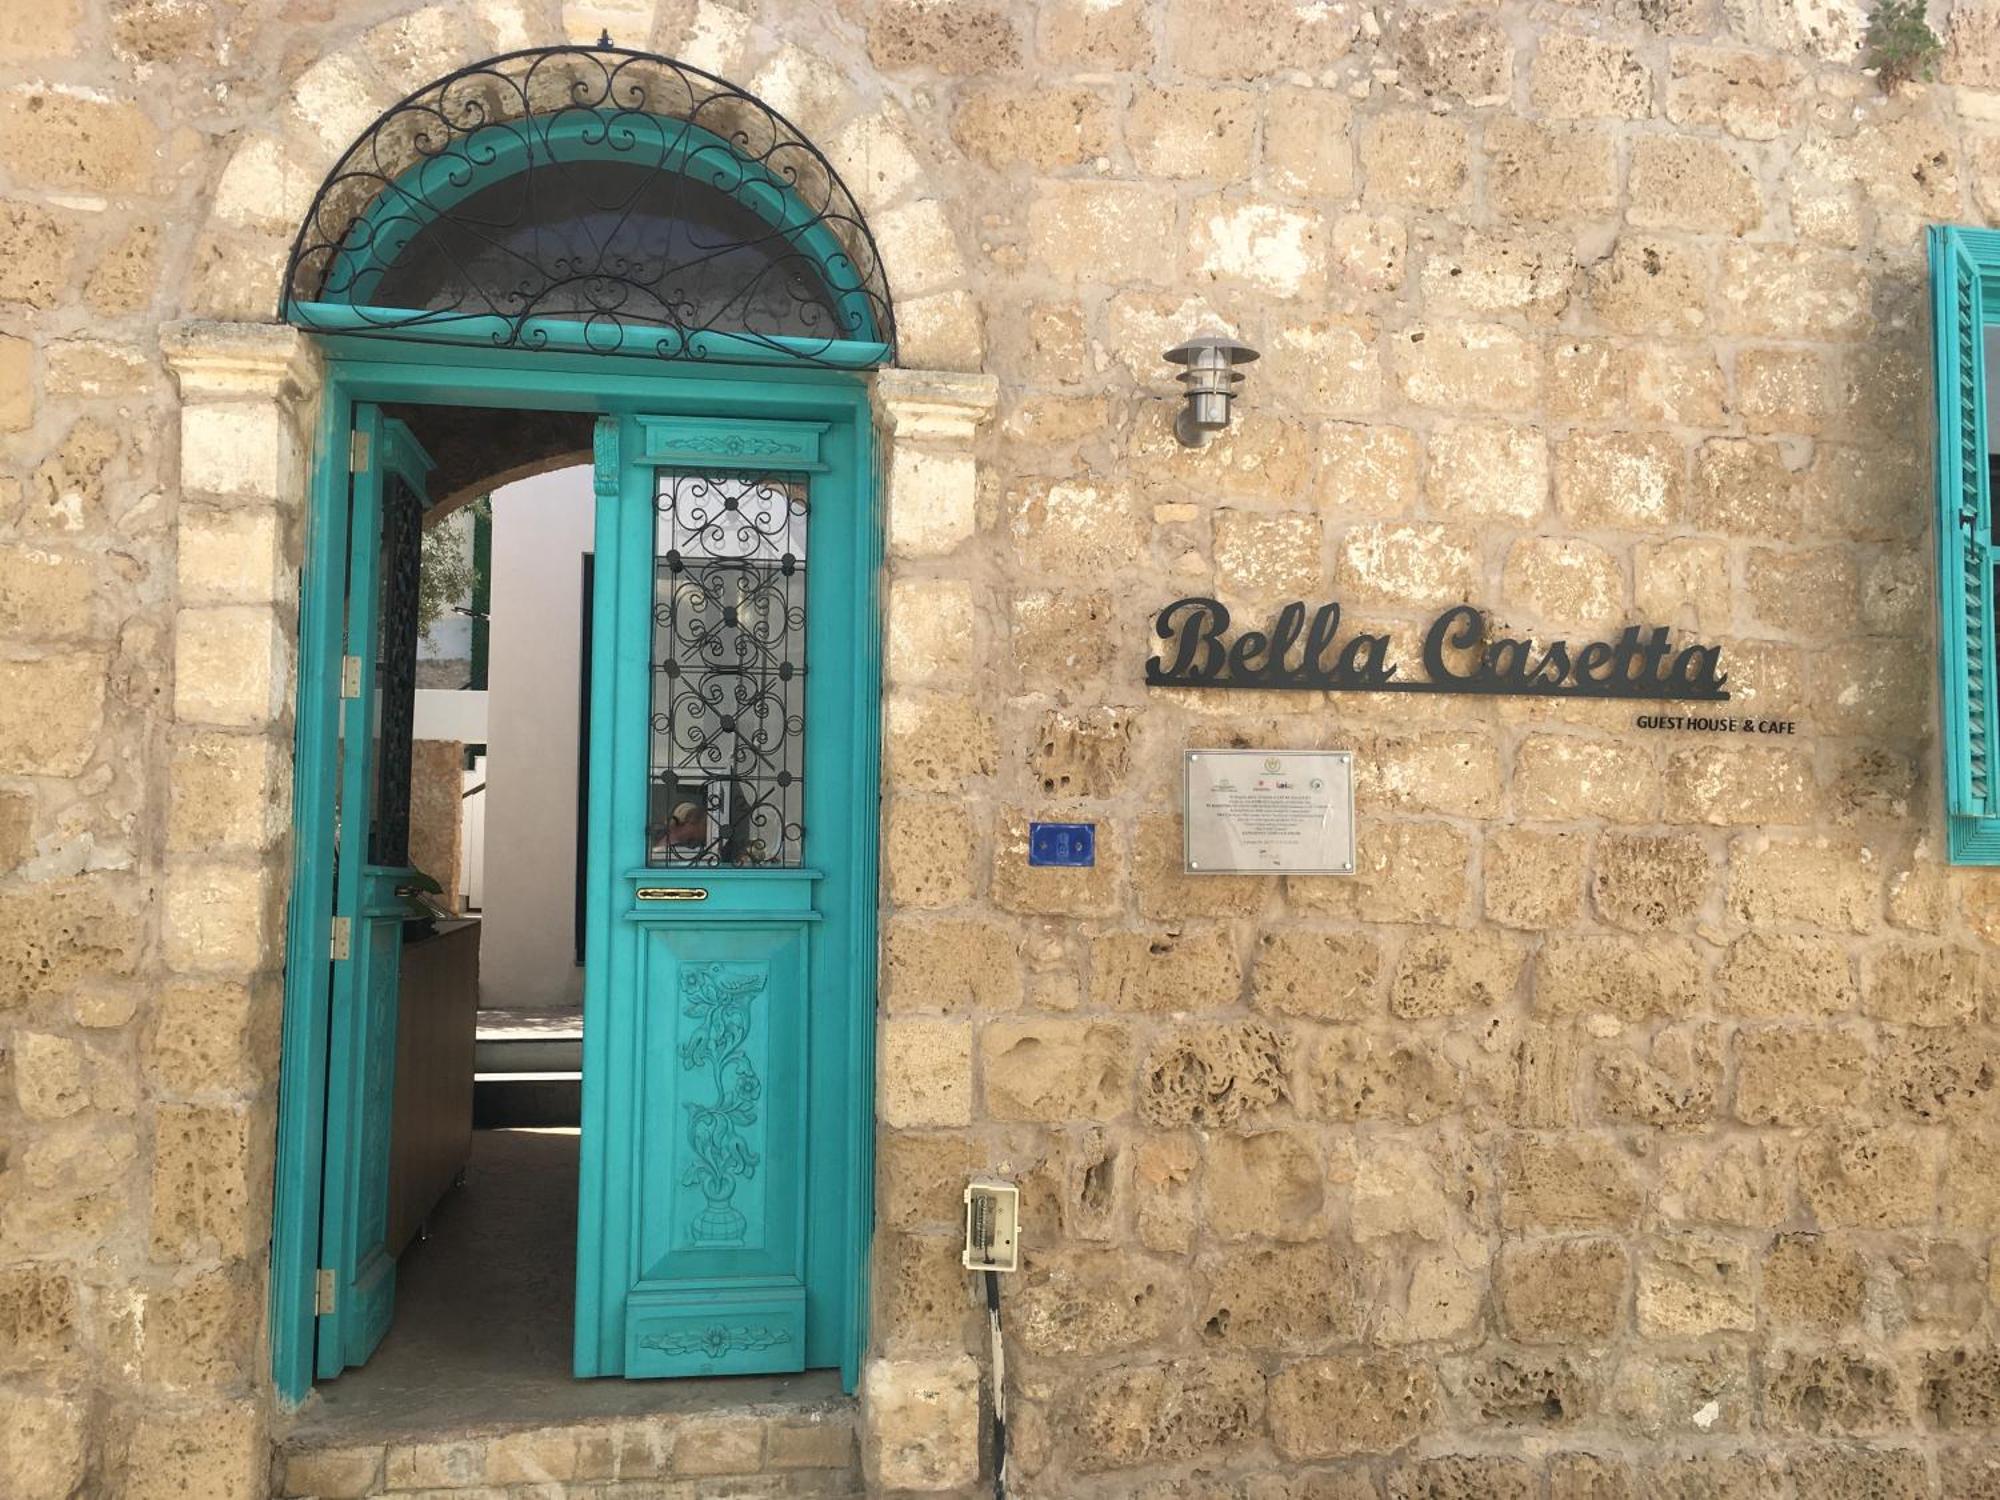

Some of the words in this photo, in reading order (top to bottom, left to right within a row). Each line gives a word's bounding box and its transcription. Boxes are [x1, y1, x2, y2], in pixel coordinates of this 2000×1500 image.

[1145, 597, 1397, 684] Bella
[1423, 605, 1728, 693] Casetta
[1637, 715, 1684, 730] GUEST
[1687, 717, 1736, 732] HOUSE
[1743, 719, 1755, 733] &
[1758, 720, 1796, 735] CAFE
